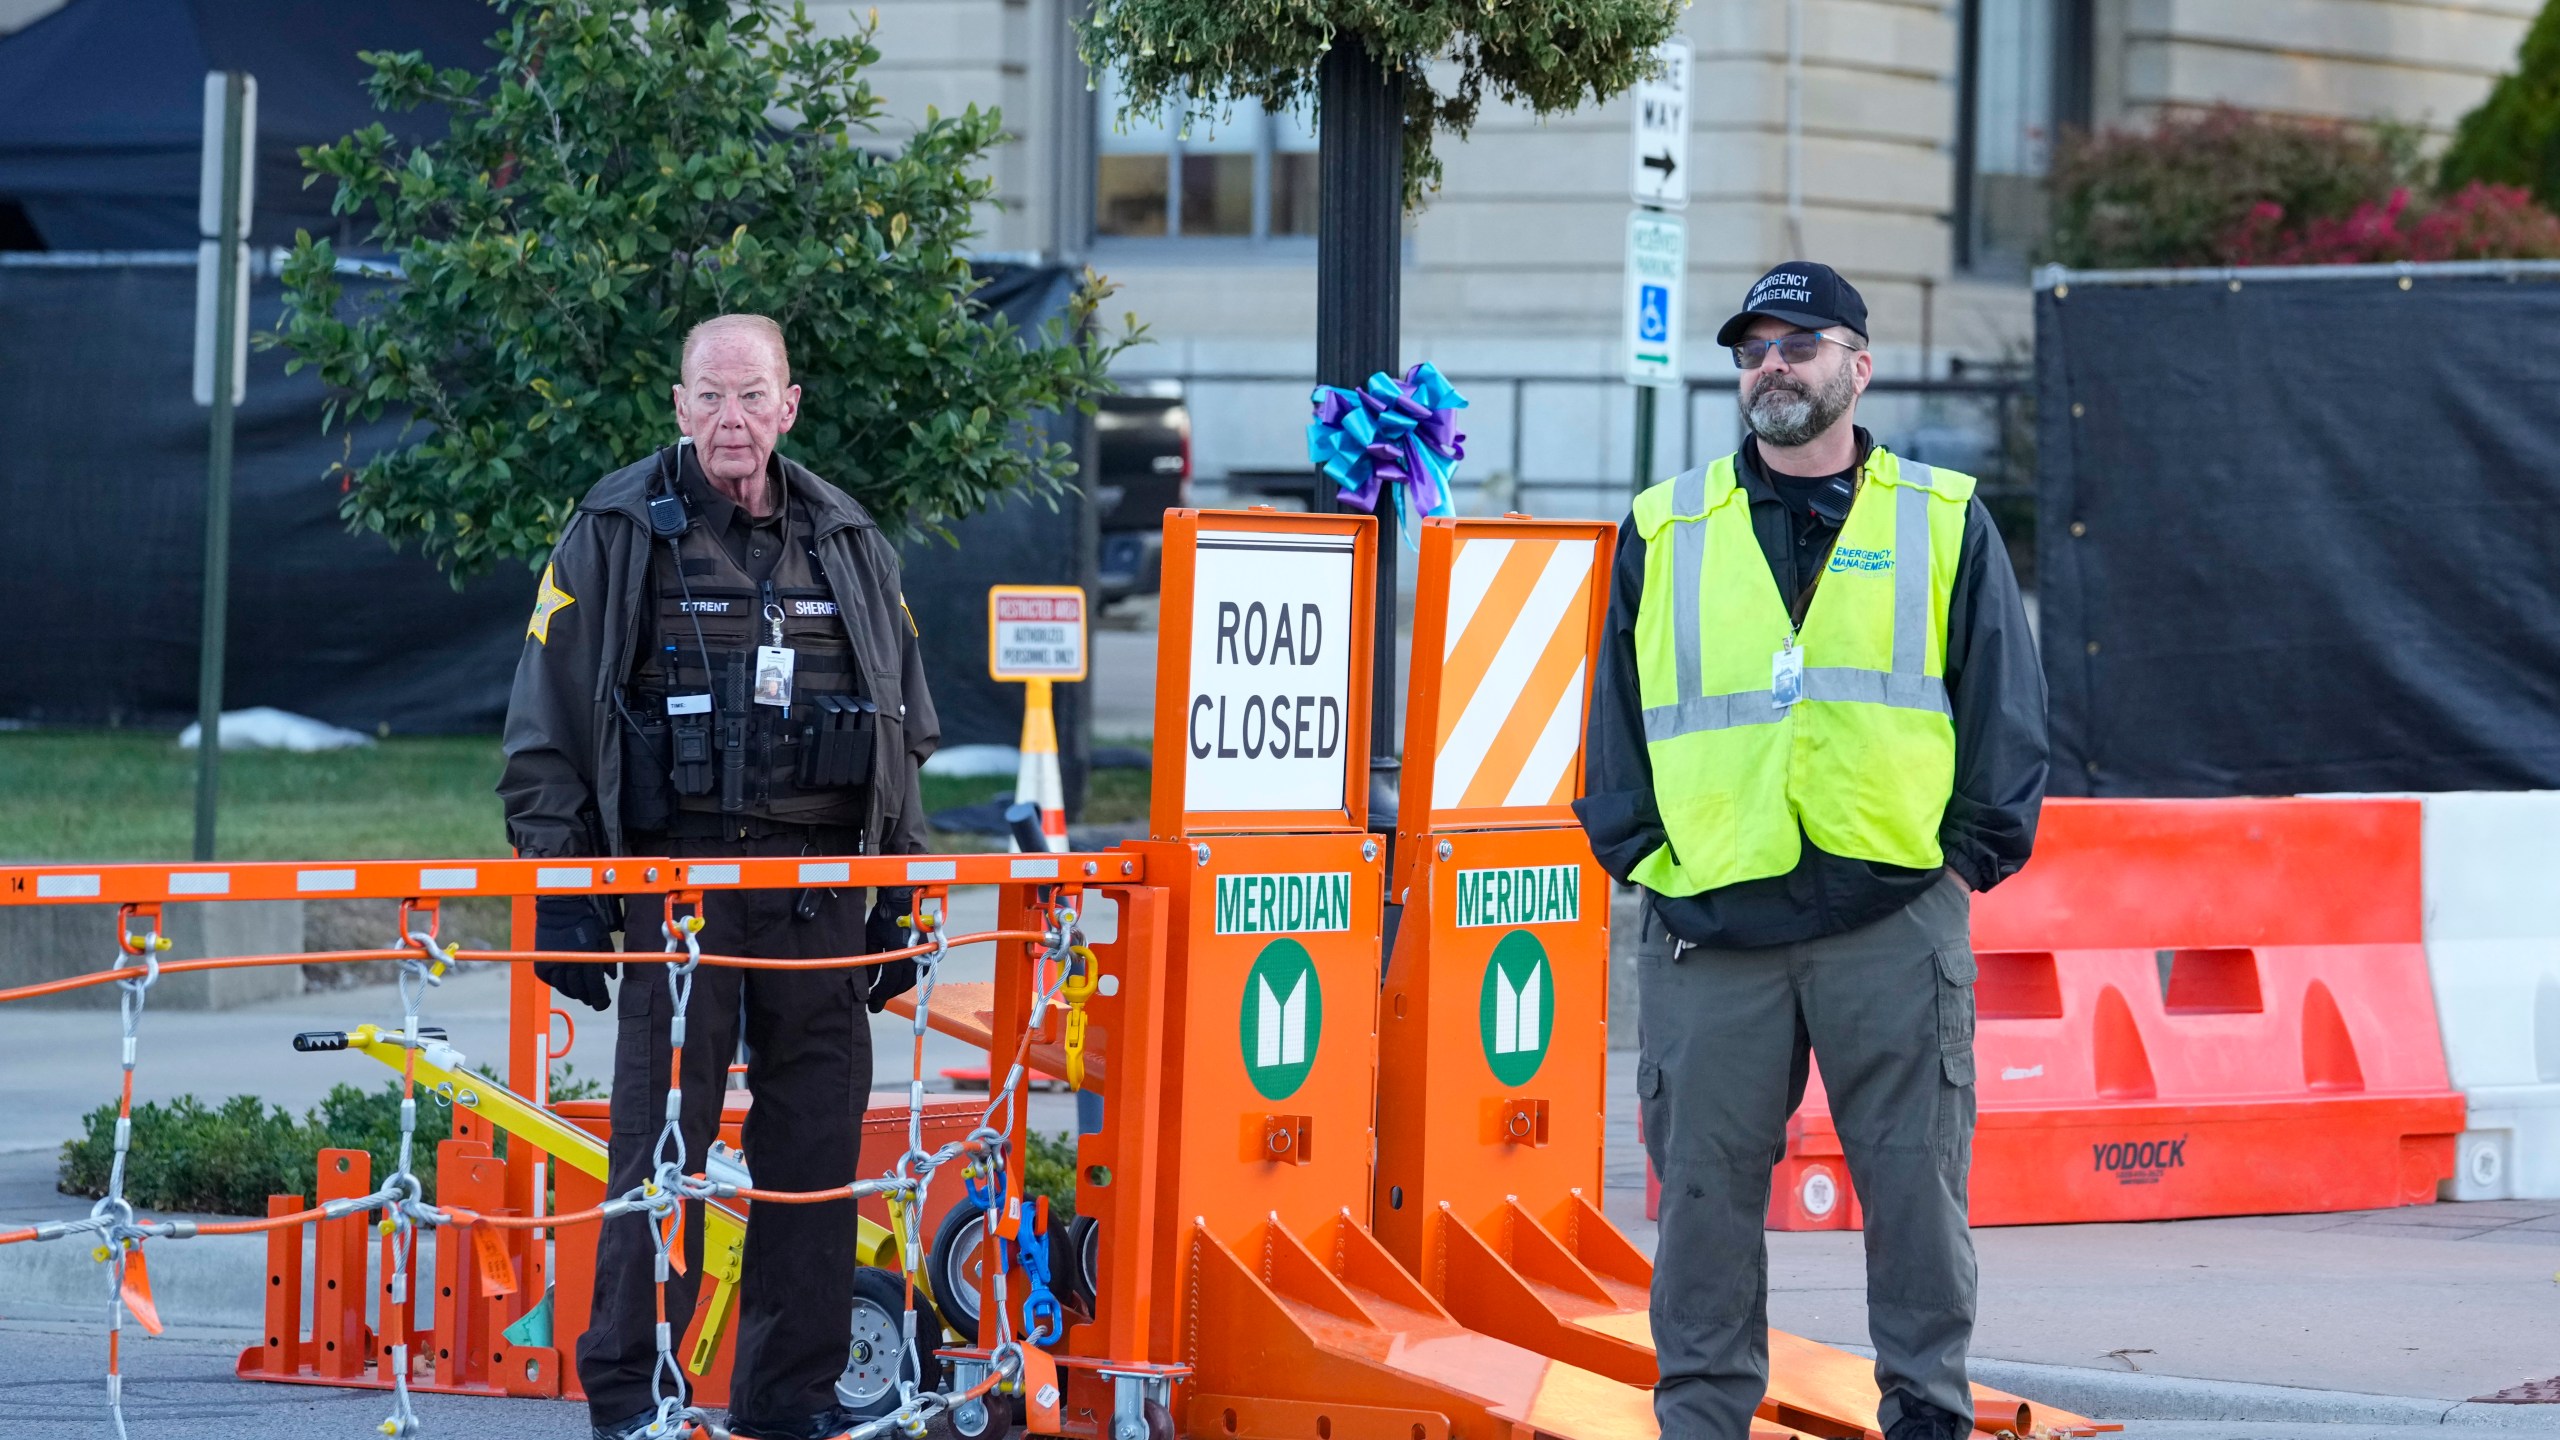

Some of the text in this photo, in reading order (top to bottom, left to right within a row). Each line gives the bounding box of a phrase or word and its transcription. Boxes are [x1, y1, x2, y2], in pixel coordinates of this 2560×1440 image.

[1642, 100, 1682, 135] WAY
[1752, 273, 1808, 297] EMERGENCY
[1746, 288, 1812, 312] MANAGEMENT
[1832, 557, 1895, 571] MANAGEMENT
[1835, 546, 1892, 561] EMERGENCY
[692, 601, 729, 612] TRENT
[1000, 599, 1079, 619] RESTRICTED AREA
[1014, 626, 1064, 643] AUTHORIZED
[1216, 600, 1323, 666] ROAD
[1003, 647, 1075, 664] PERSONNEL ONLY
[1189, 693, 1340, 760] CLOSED
[11, 877, 24, 893] 14
[1458, 866, 1578, 926] MERIDIAN
[1217, 875, 1349, 933] MERIDIAN
[2092, 1139, 2187, 1171] YODOCK
